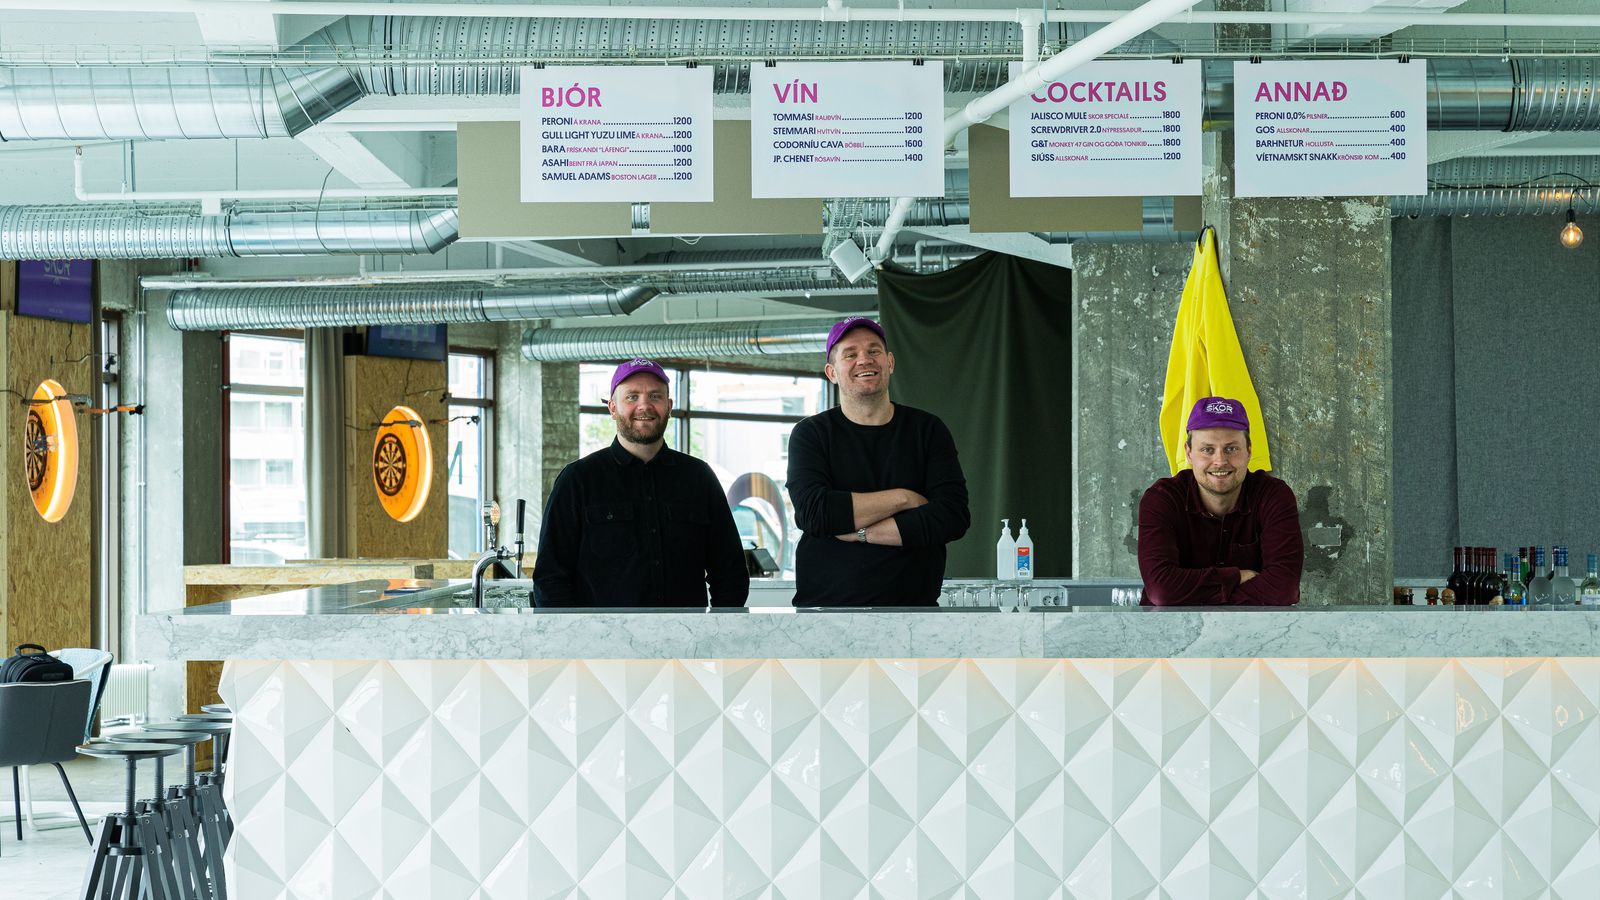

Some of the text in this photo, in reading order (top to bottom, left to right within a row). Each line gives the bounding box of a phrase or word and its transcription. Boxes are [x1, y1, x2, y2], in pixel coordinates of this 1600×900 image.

[542, 83, 602, 107] BJÓR
[773, 79, 818, 103] VÍN
[1255, 82, 1348, 102] ANNAÐ
[773, 140, 819, 148] CODORNÍU
[1031, 152, 1055, 161] SJÚSS
[1256, 152, 1308, 161] VÍETNAMSKT
[1206, 404, 1233, 413] SKOR
